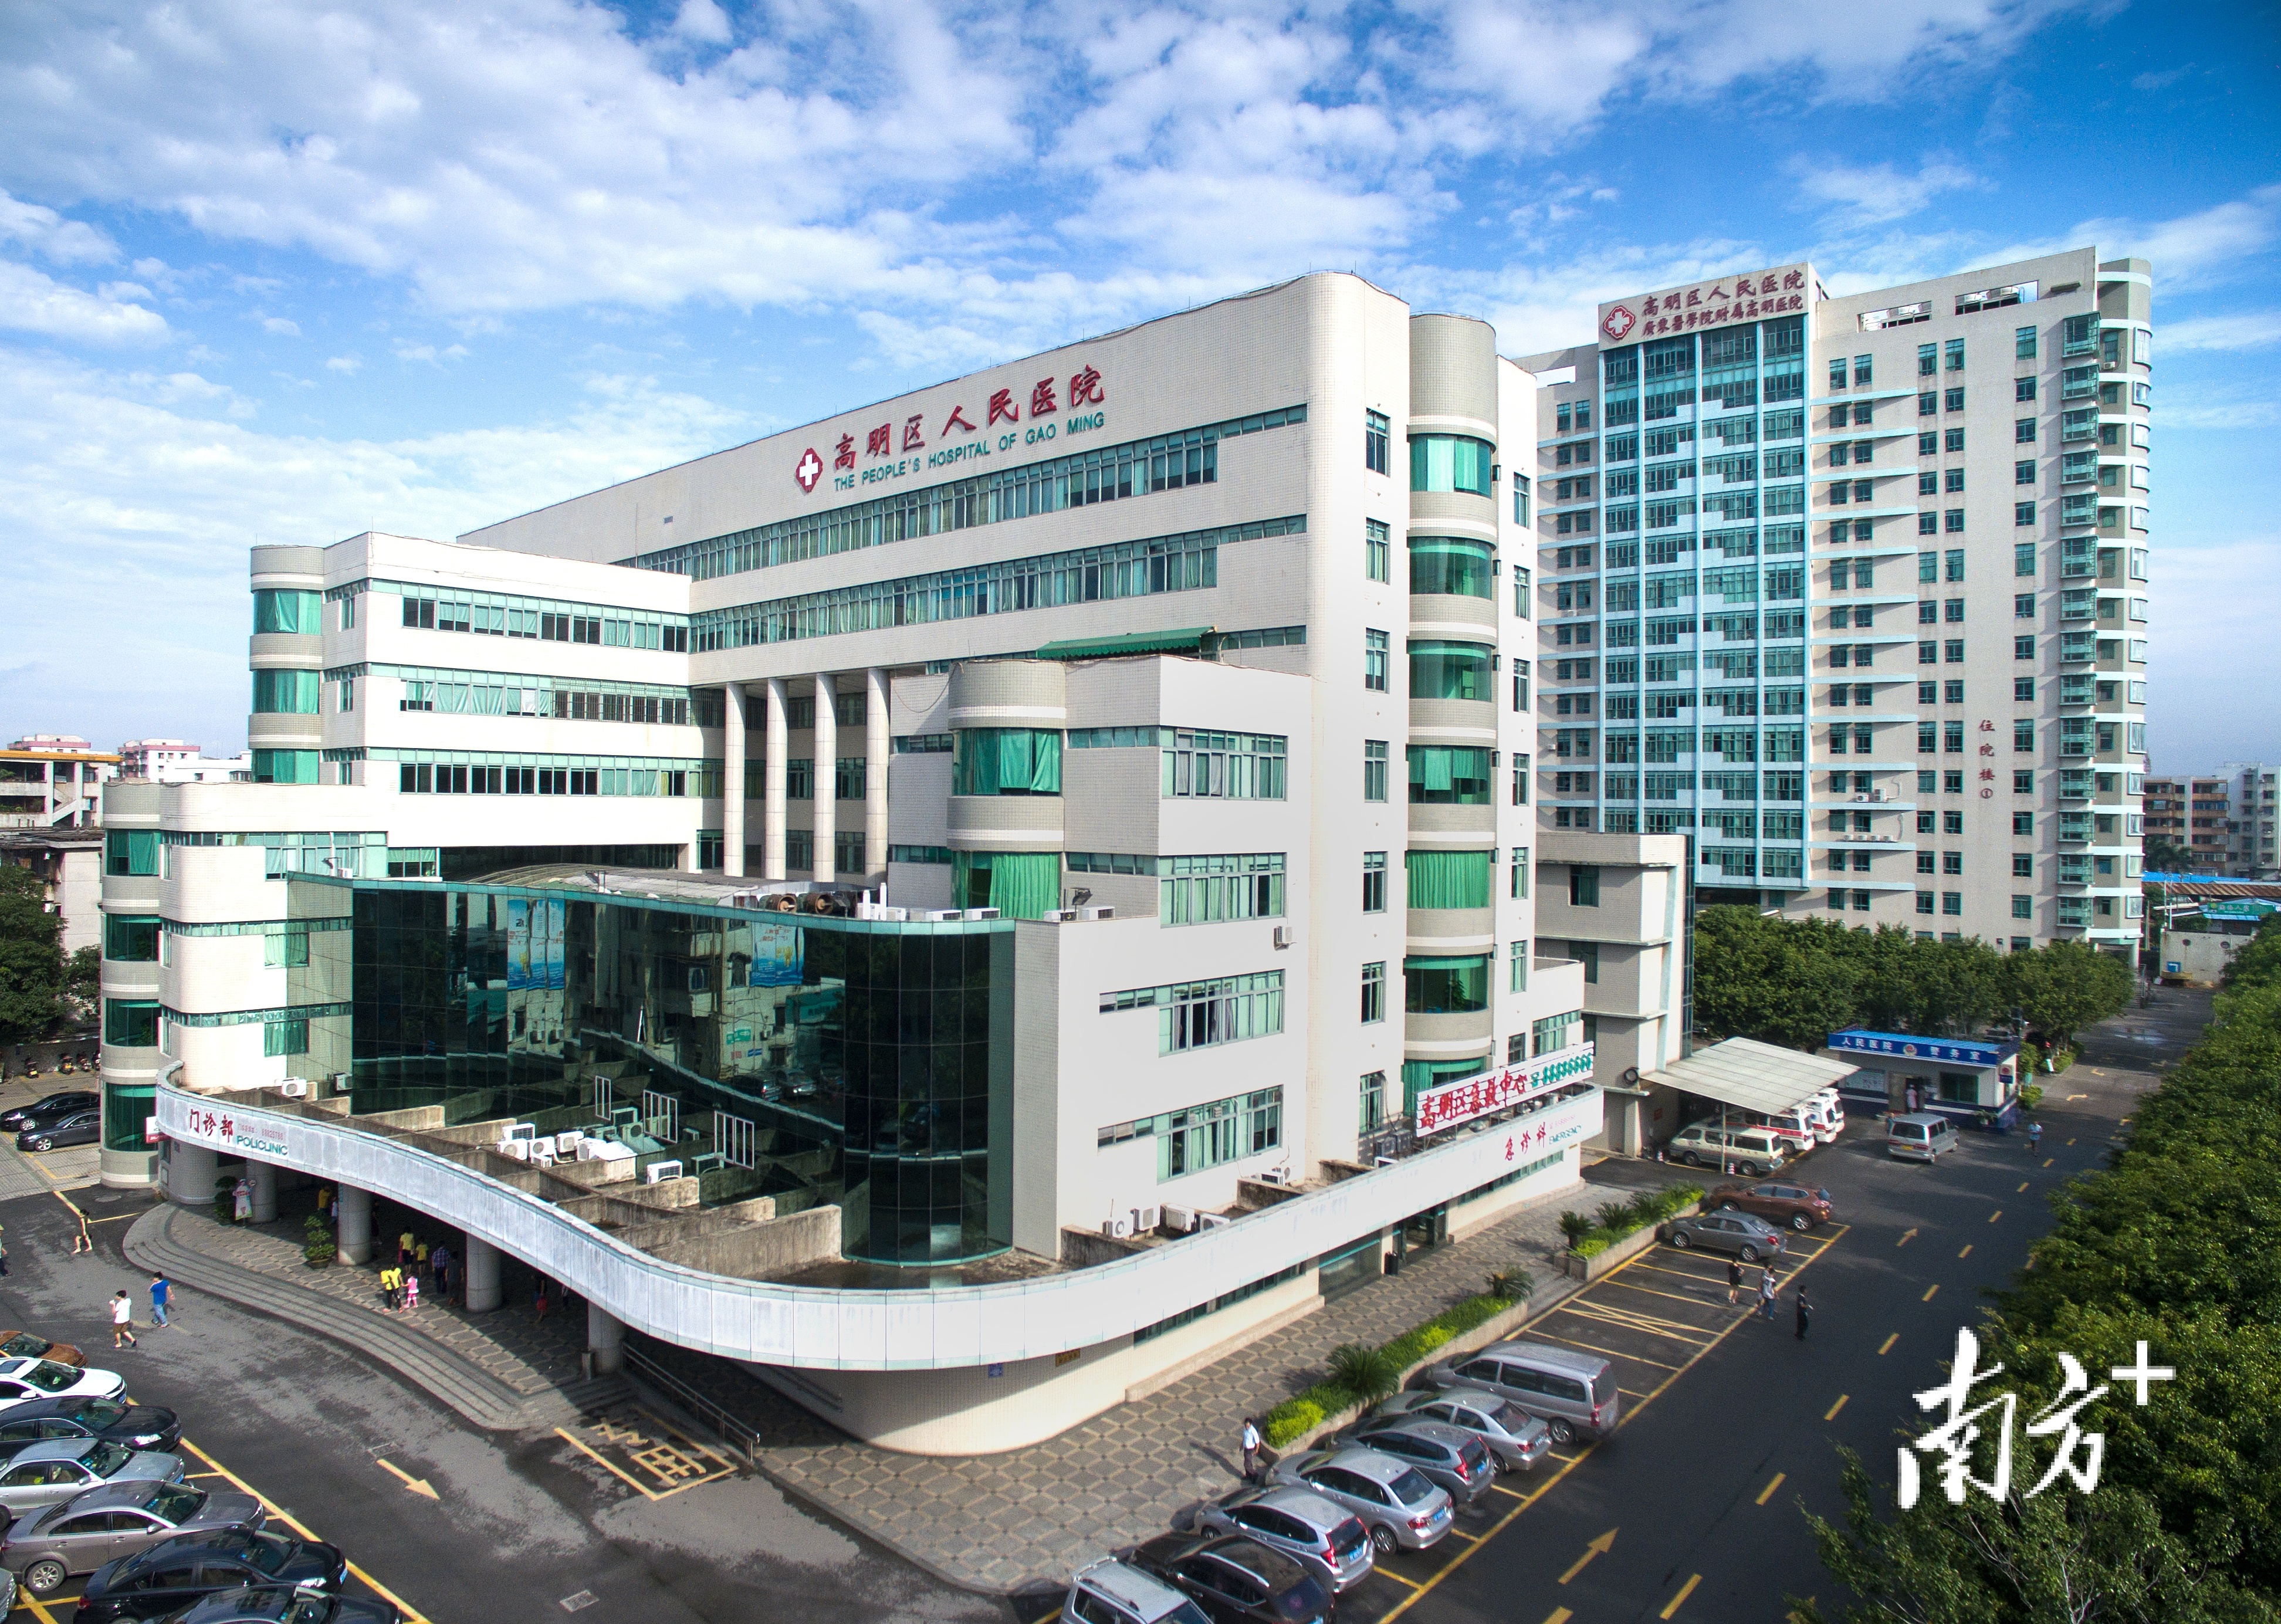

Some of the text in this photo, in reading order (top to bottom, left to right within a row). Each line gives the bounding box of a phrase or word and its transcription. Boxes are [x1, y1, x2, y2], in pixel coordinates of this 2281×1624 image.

[1643, 269, 1805, 317] 高明区人民医院
[834, 364, 1105, 471] 高明区人民医院
[834, 411, 1104, 491] THE PEOPLE'S HOSPITAL OF GAO MING
[1842, 1036, 1981, 1061] 人民医院 警务室
[189, 1108, 233, 1143] 门诊部
[1505, 1121, 1546, 1162] 急诊科
[1549, 1124, 1583, 1145] EMERGENCY
[236, 1135, 288, 1156] POLICLINIC
